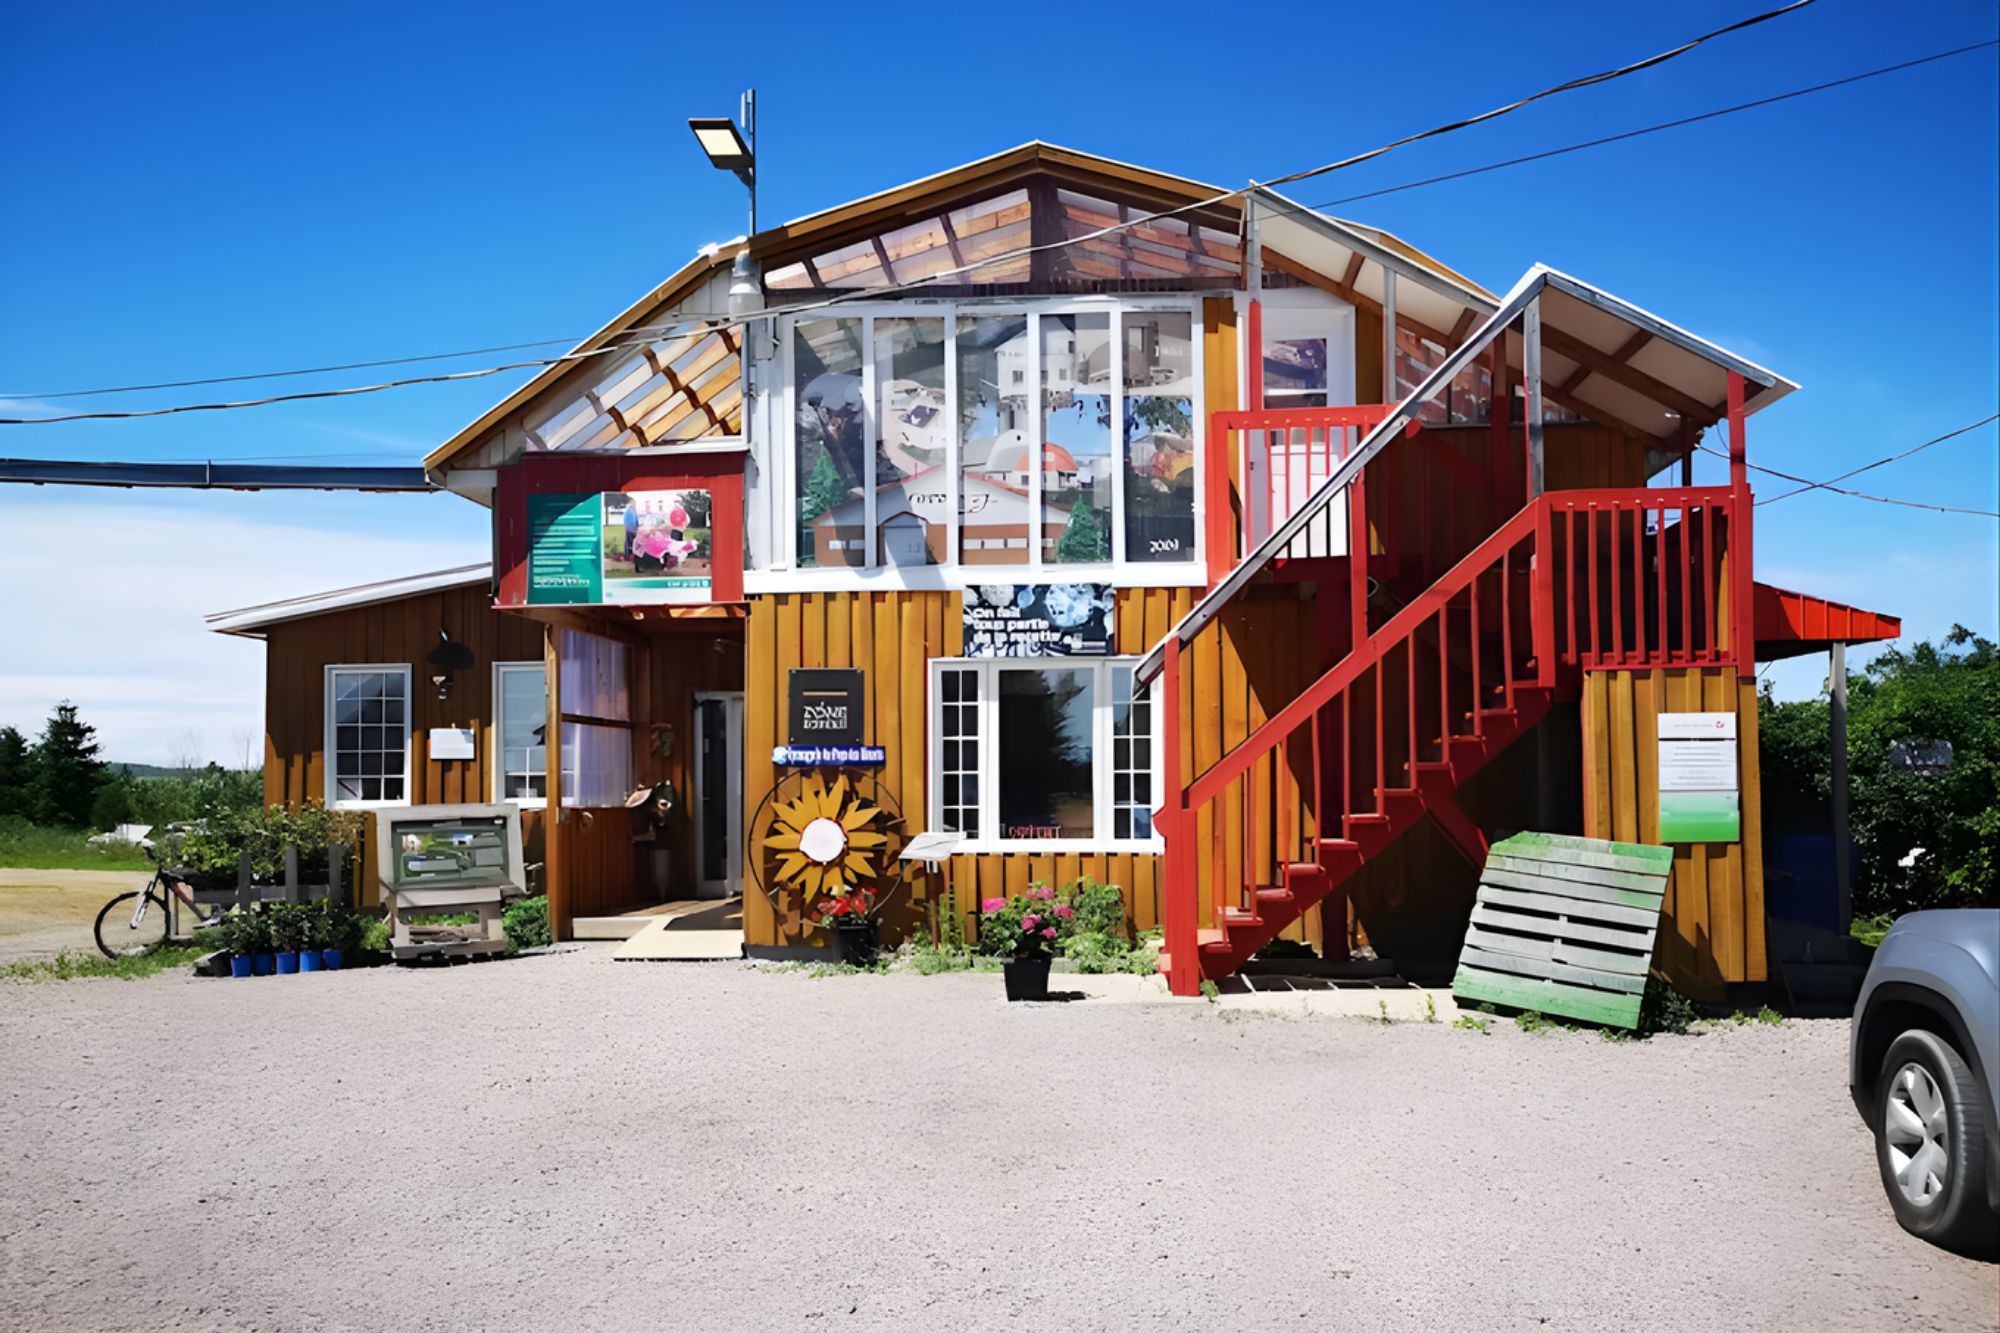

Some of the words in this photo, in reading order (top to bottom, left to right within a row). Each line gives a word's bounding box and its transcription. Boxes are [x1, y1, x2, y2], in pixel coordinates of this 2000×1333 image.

[973, 607, 995, 619] On
[996, 606, 1021, 618] fait
[973, 619, 1005, 630] tous
[1007, 618, 1050, 631] partie
